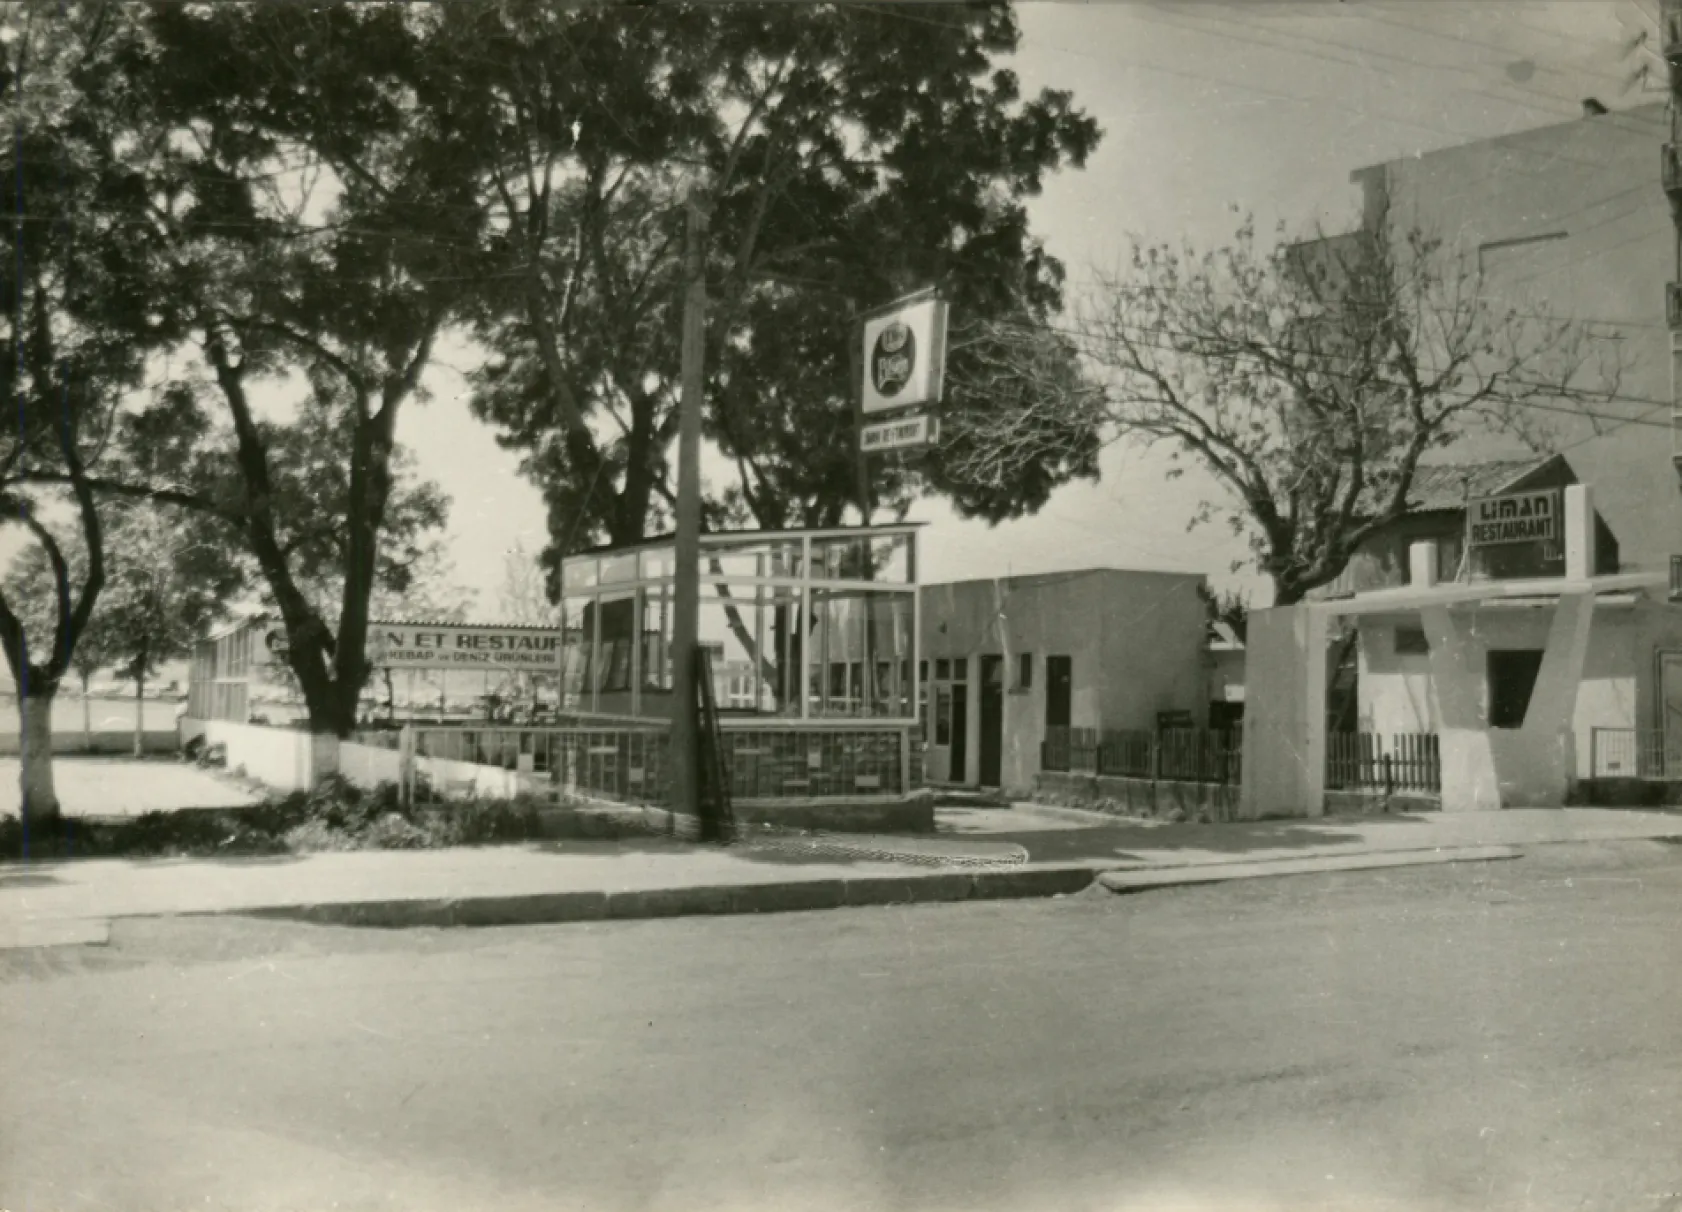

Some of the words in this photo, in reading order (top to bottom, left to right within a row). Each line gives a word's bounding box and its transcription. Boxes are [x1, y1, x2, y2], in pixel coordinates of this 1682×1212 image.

[1472, 517, 1552, 541] RESTAURANT
[415, 632, 447, 648] ET
[455, 633, 562, 651] RESTAUR
